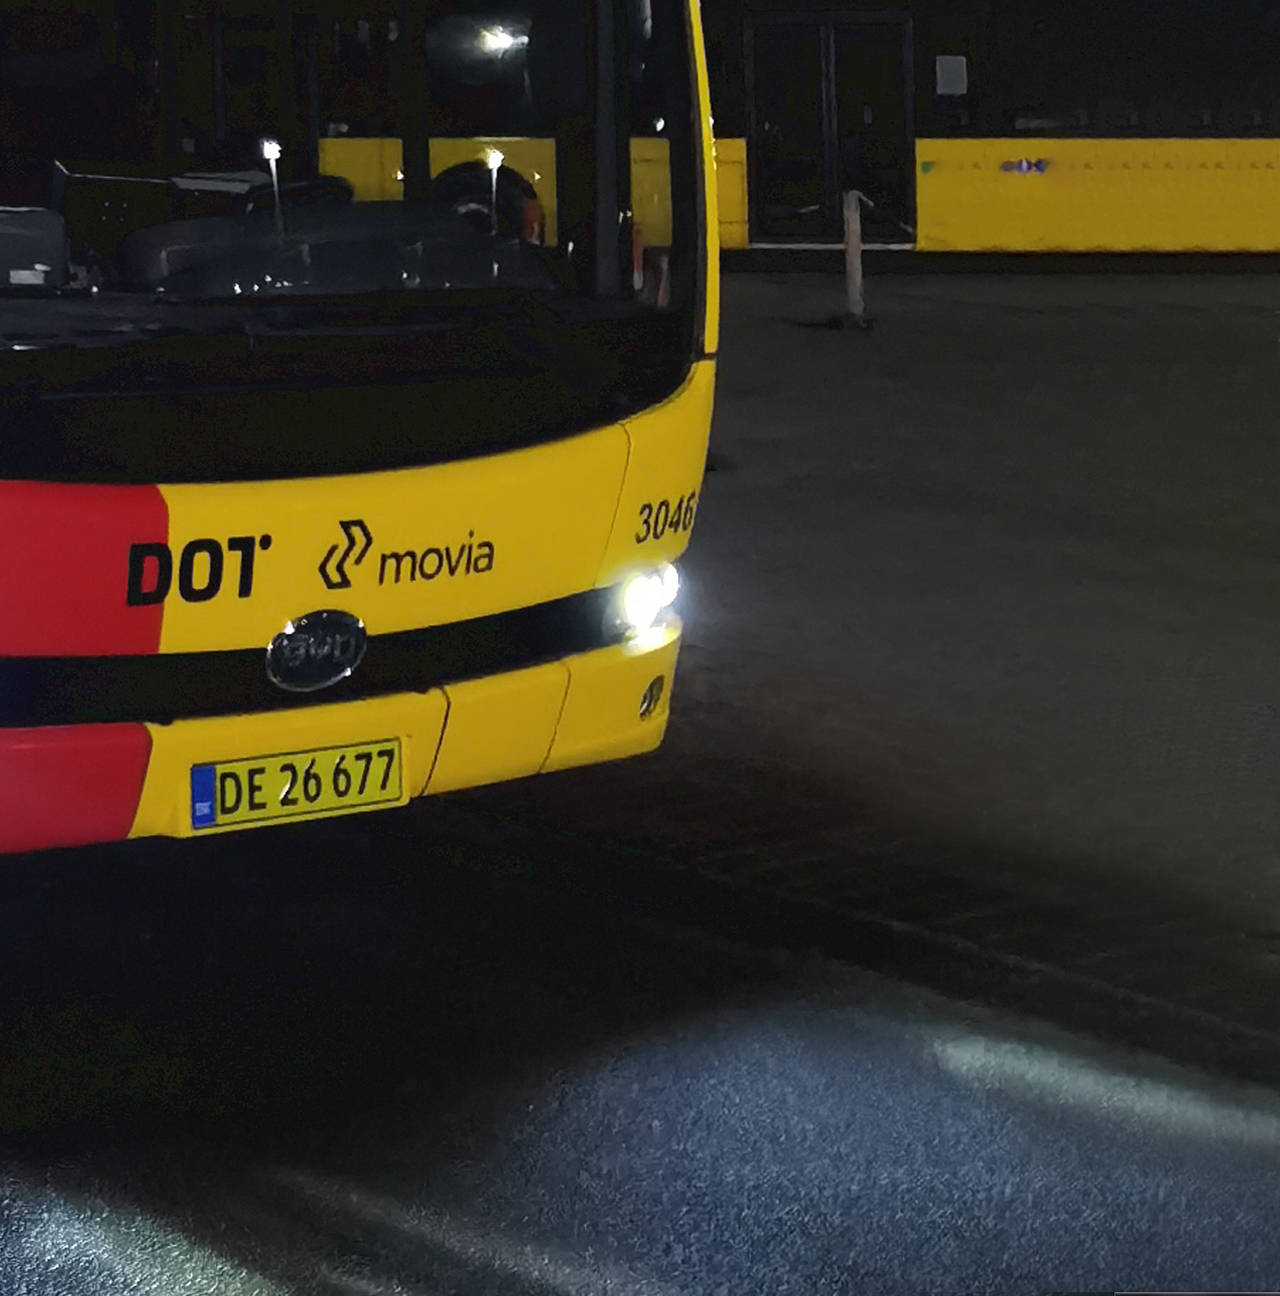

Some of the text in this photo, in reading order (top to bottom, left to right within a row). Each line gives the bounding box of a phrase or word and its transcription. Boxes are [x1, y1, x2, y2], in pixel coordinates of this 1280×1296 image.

[635, 488, 697, 544] 3046
[127, 535, 257, 606] DOT
[379, 529, 495, 586] movia
[219, 748, 395, 815] DE 26 677
